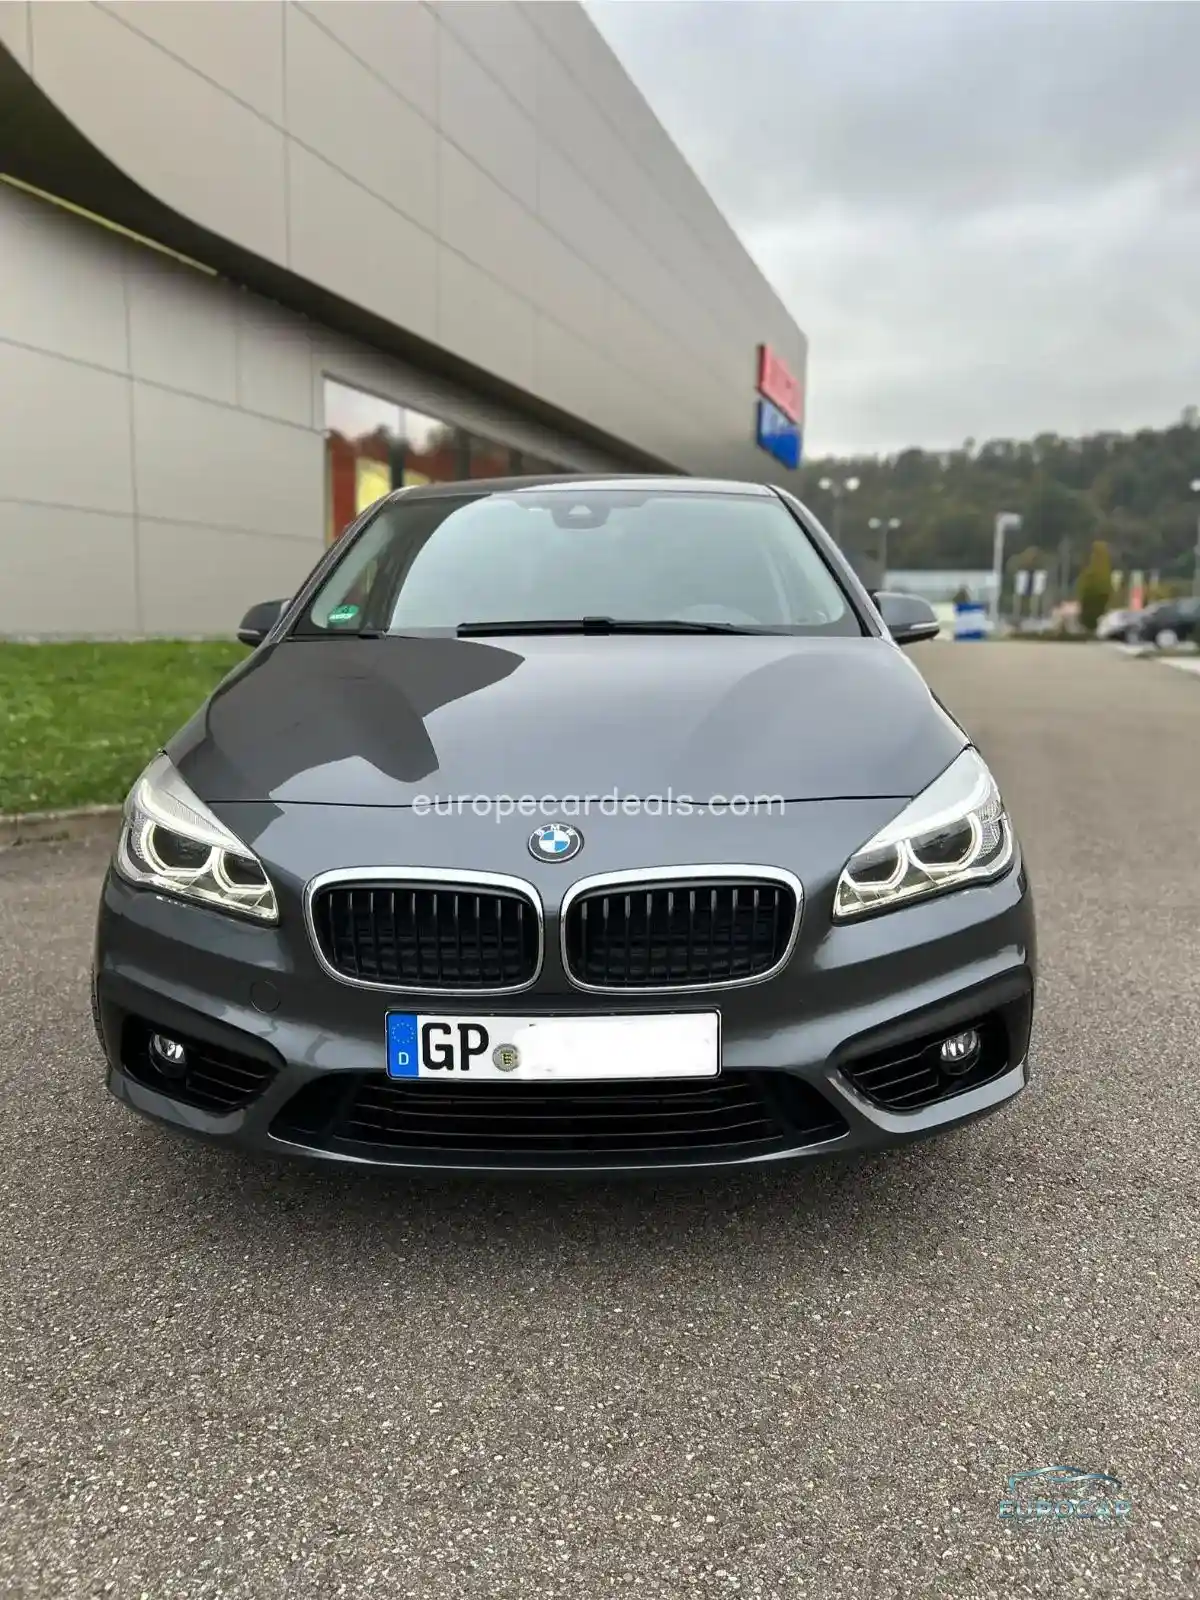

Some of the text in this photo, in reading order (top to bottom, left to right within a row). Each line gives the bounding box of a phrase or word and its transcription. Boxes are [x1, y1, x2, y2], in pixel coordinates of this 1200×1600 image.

[533, 823, 577, 837] BMW
[422, 1022, 489, 1072] GP
[398, 1052, 409, 1066] D
